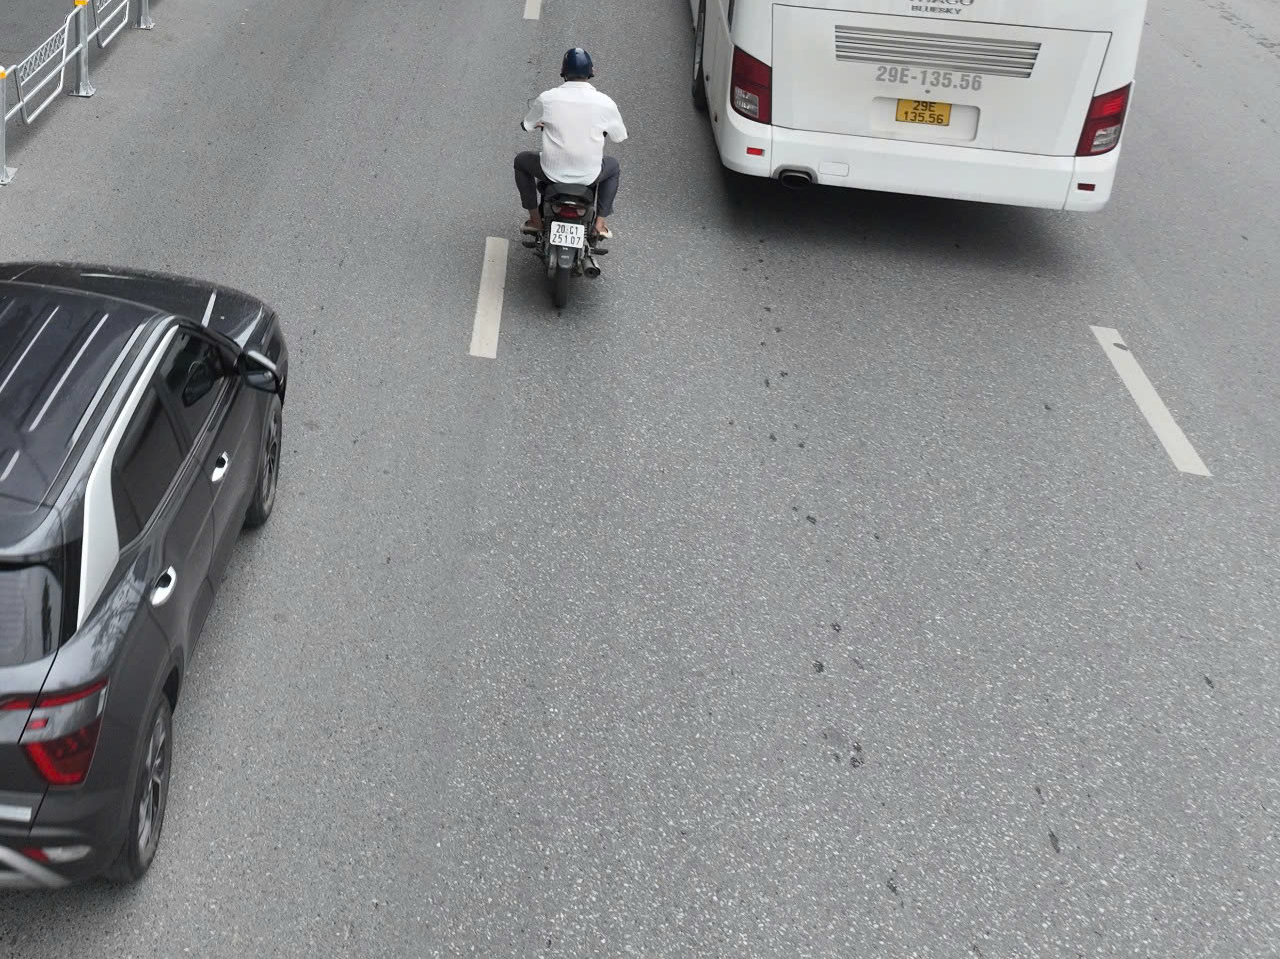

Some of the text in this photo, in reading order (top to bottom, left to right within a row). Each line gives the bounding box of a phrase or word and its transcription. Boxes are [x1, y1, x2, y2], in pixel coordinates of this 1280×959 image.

[911, 5, 962, 15] BLUESKY
[875, 65, 982, 91] 29E-135.56
[913, 101, 936, 112] 29E
[903, 111, 943, 124] 135.56
